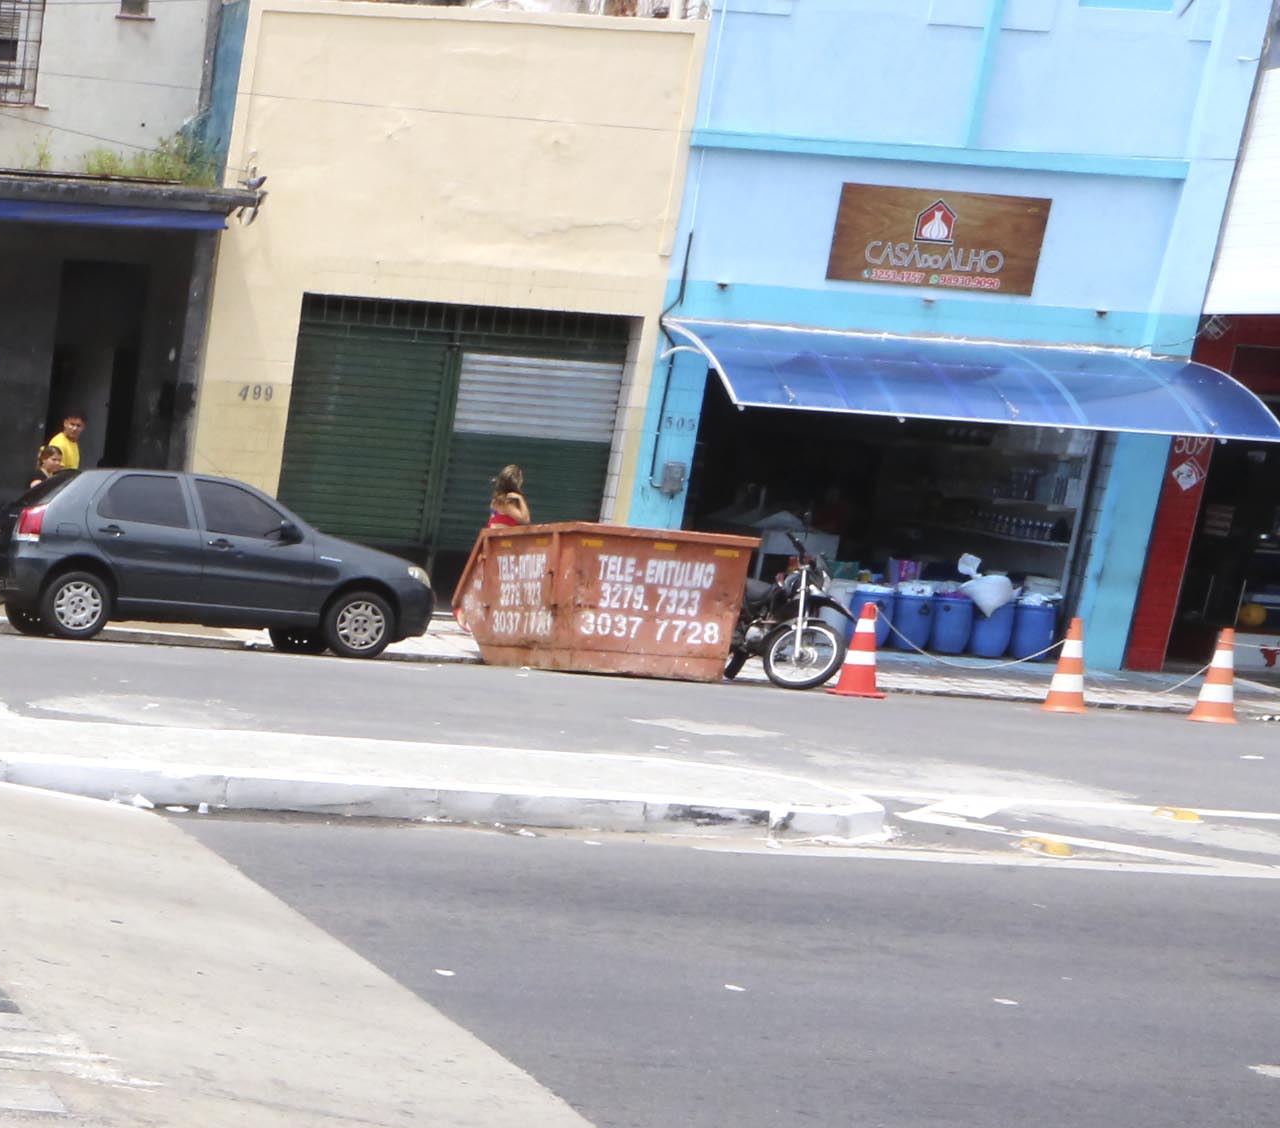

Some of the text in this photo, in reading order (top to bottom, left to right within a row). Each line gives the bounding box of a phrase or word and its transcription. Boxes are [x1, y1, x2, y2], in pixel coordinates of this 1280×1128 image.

[238, 384, 273, 401] 499
[656, 587, 701, 617] 7323
[580, 613, 720, 645] 3037 7728
